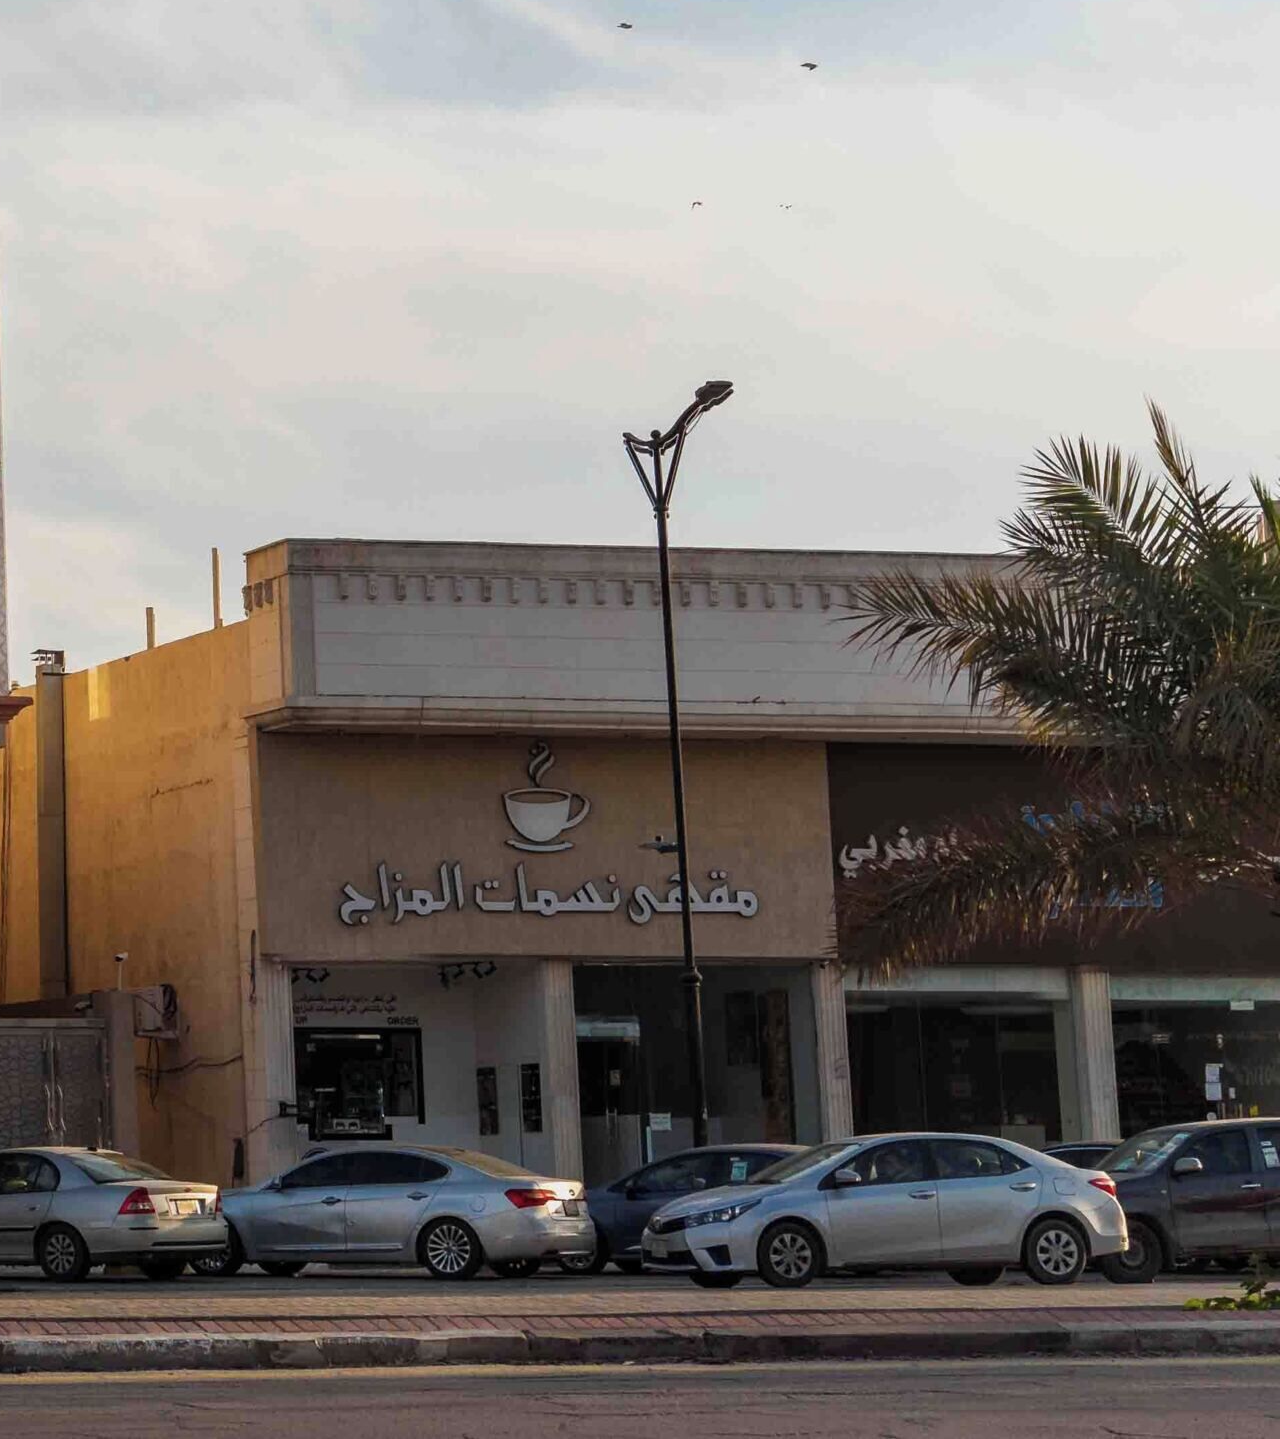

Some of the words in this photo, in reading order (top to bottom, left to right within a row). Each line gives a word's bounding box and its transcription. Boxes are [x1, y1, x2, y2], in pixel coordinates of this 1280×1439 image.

[339, 860, 465, 926] المزاج
[474, 861, 621, 917] نسمات
[628, 869, 759, 925] مقهى
